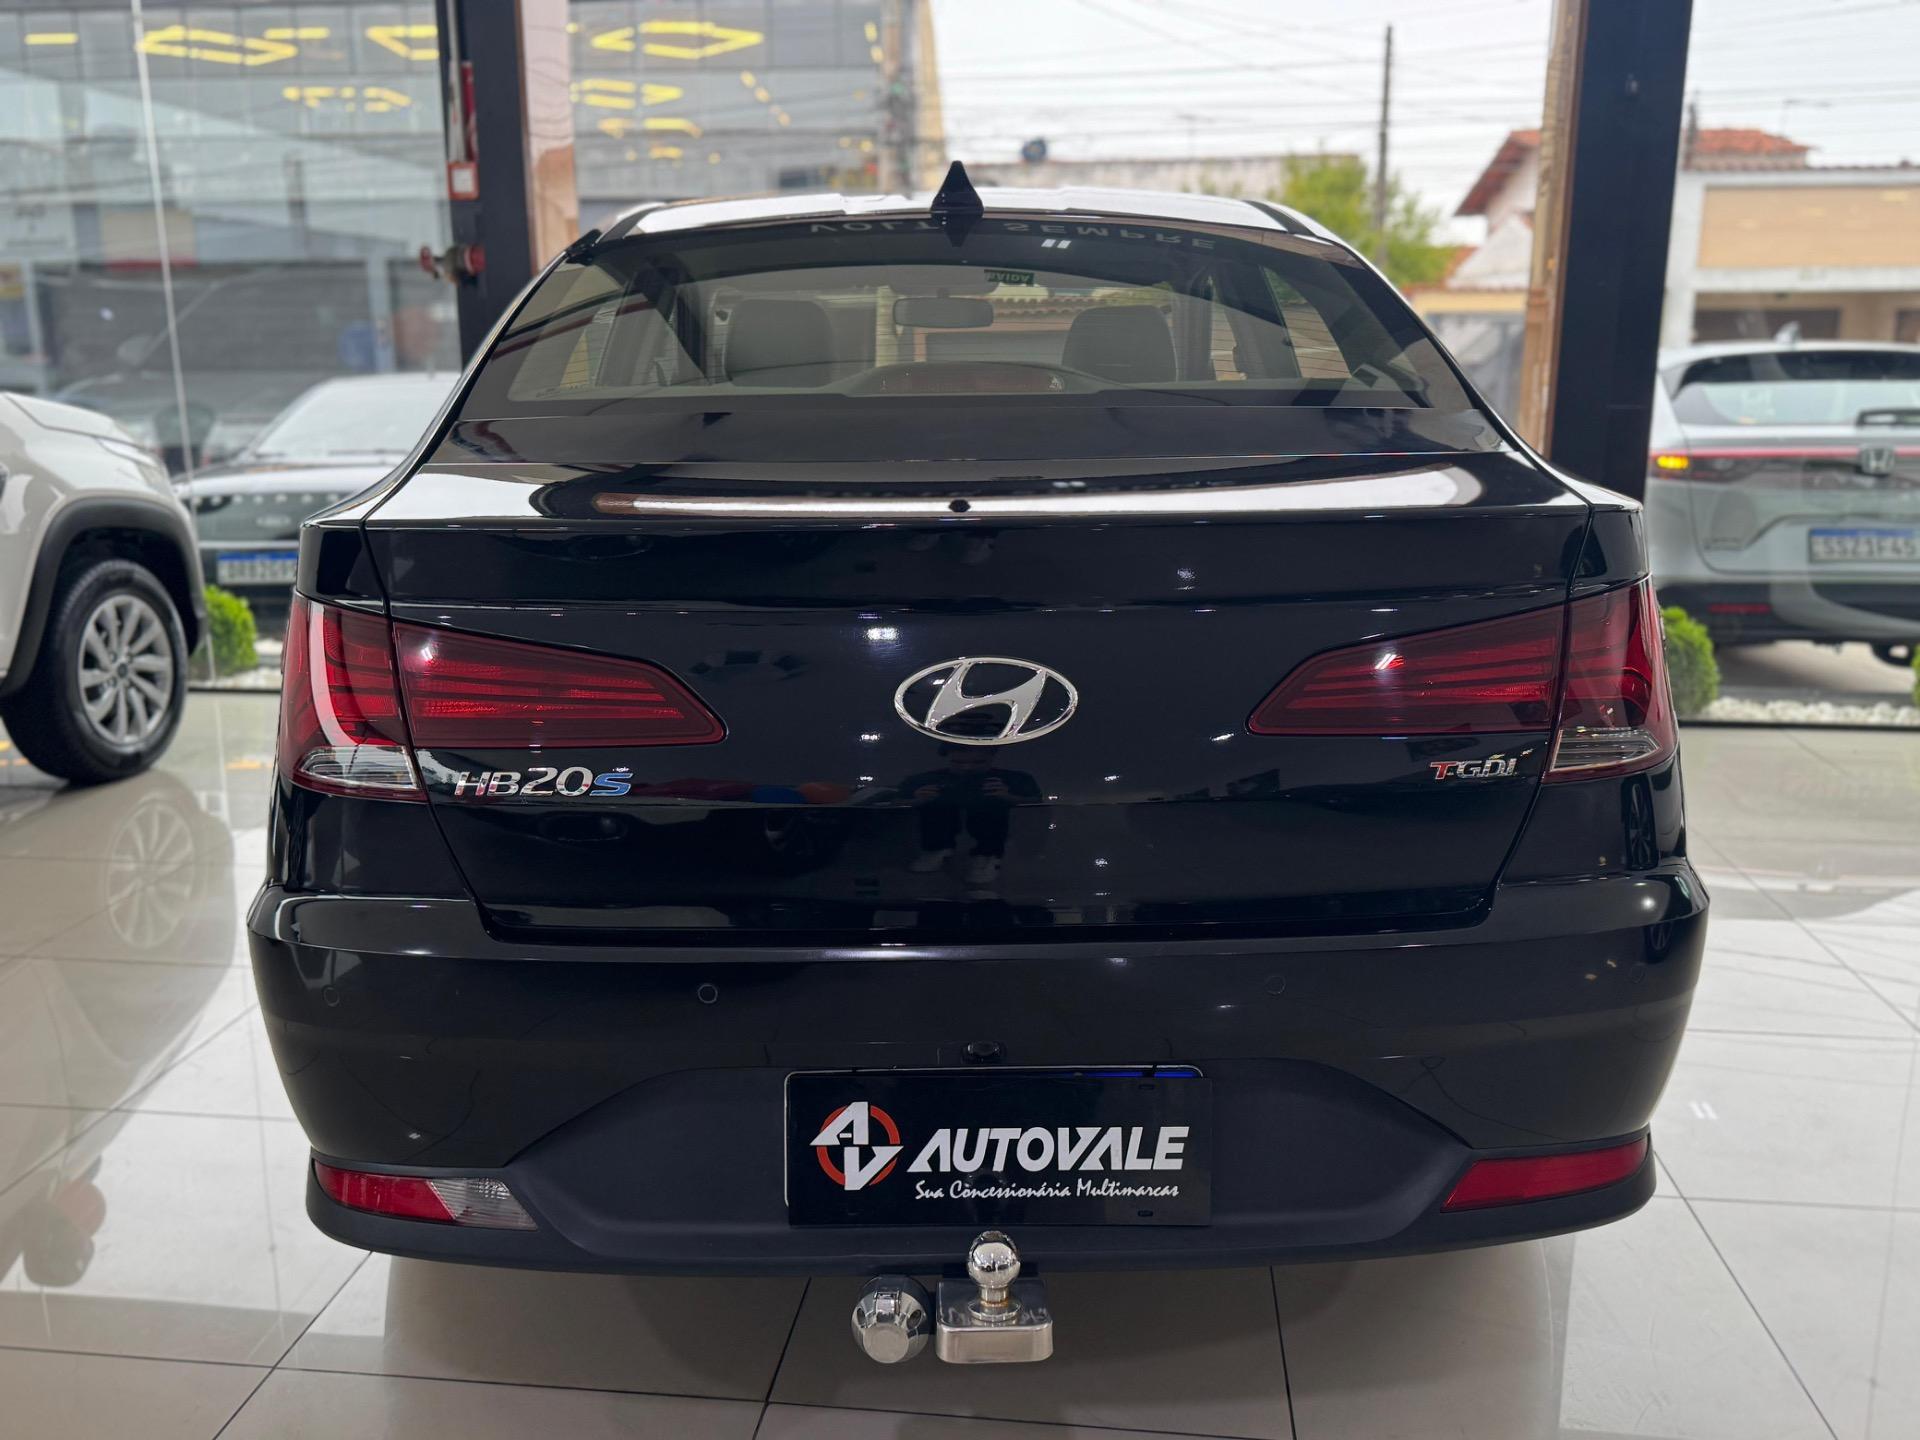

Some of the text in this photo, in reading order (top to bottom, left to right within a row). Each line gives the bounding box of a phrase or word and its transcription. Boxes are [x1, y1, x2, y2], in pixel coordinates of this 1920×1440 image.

[454, 766, 633, 797] HB20S
[907, 1126, 1190, 1172] AUTOVALE
[915, 1178, 1179, 1200] Sua Concessionária Multimarcas
